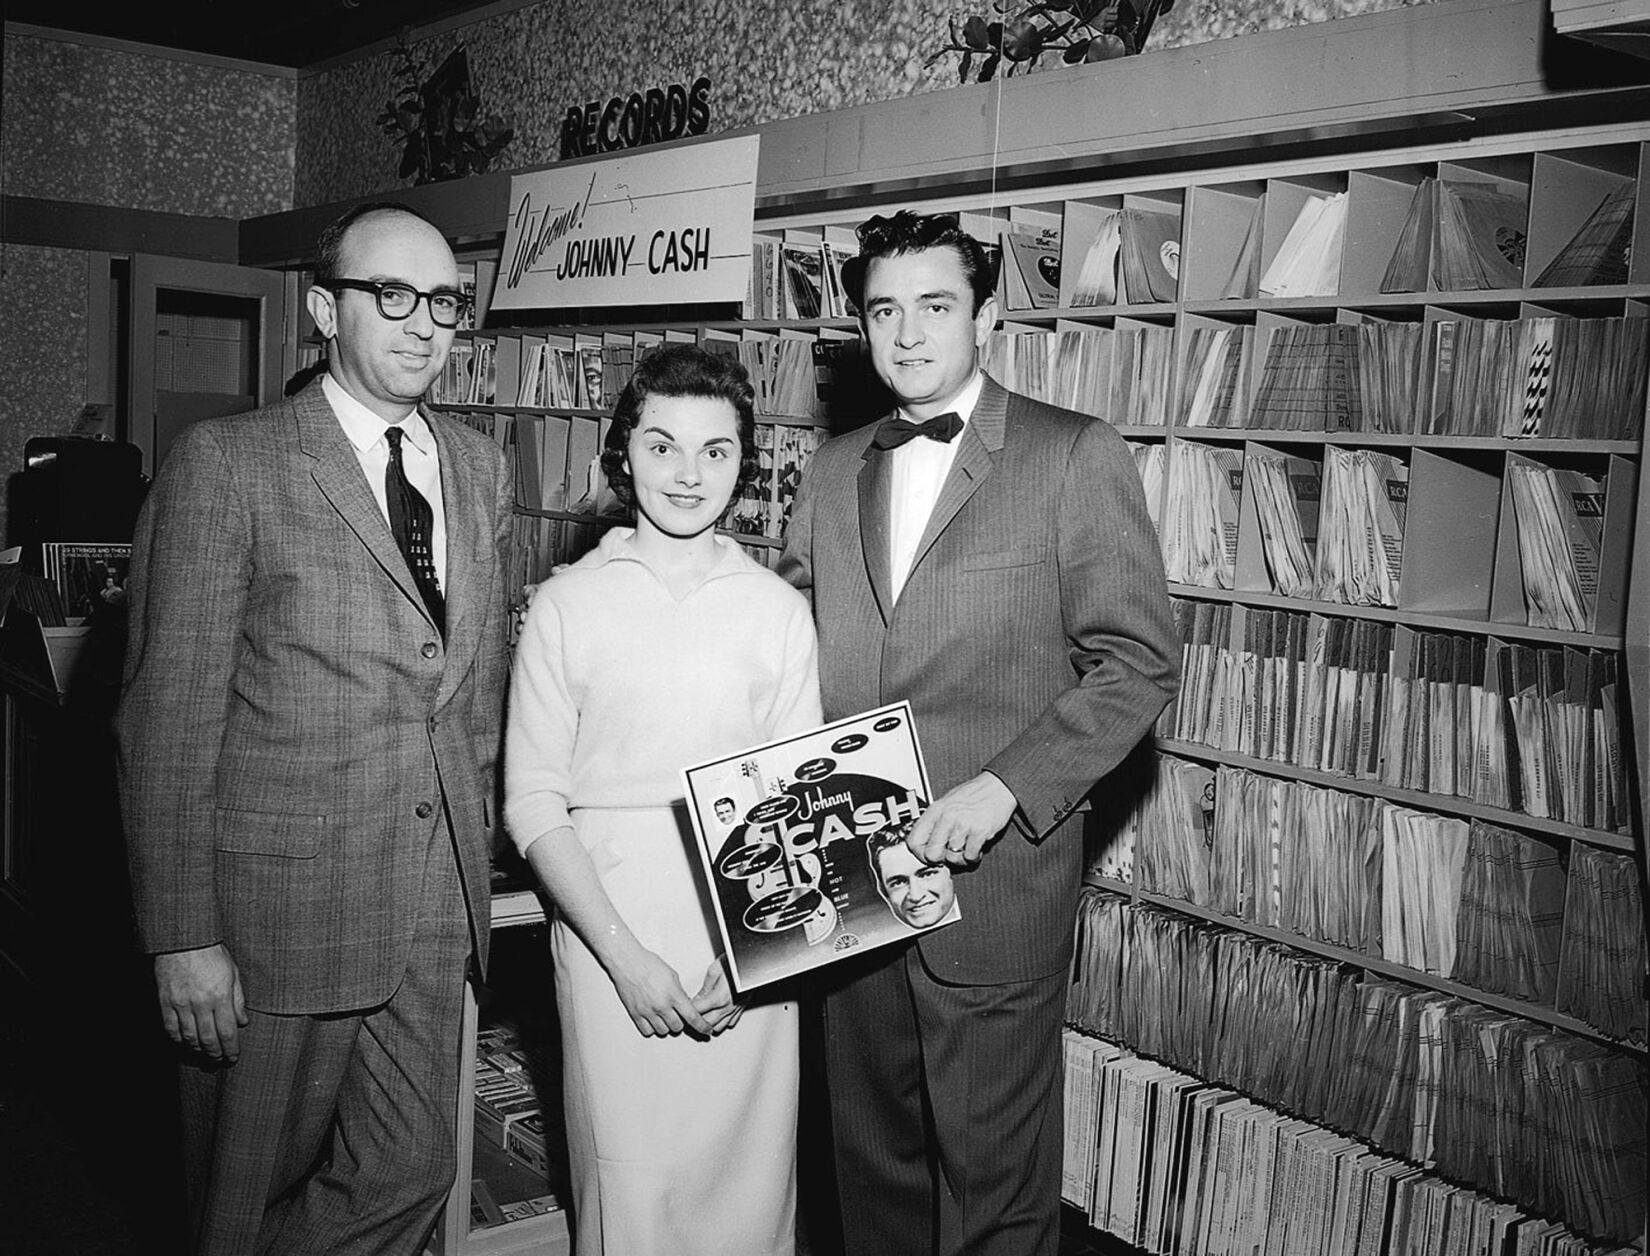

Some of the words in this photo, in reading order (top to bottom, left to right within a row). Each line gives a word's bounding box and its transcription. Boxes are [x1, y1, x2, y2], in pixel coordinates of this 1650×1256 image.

[561, 77, 711, 159] RECORDS
[507, 171, 597, 289] Welcome!
[556, 235, 636, 281] JOHNNY
[648, 227, 711, 275] CASH
[783, 788, 921, 856] CASH
[798, 786, 855, 820] Johnny
